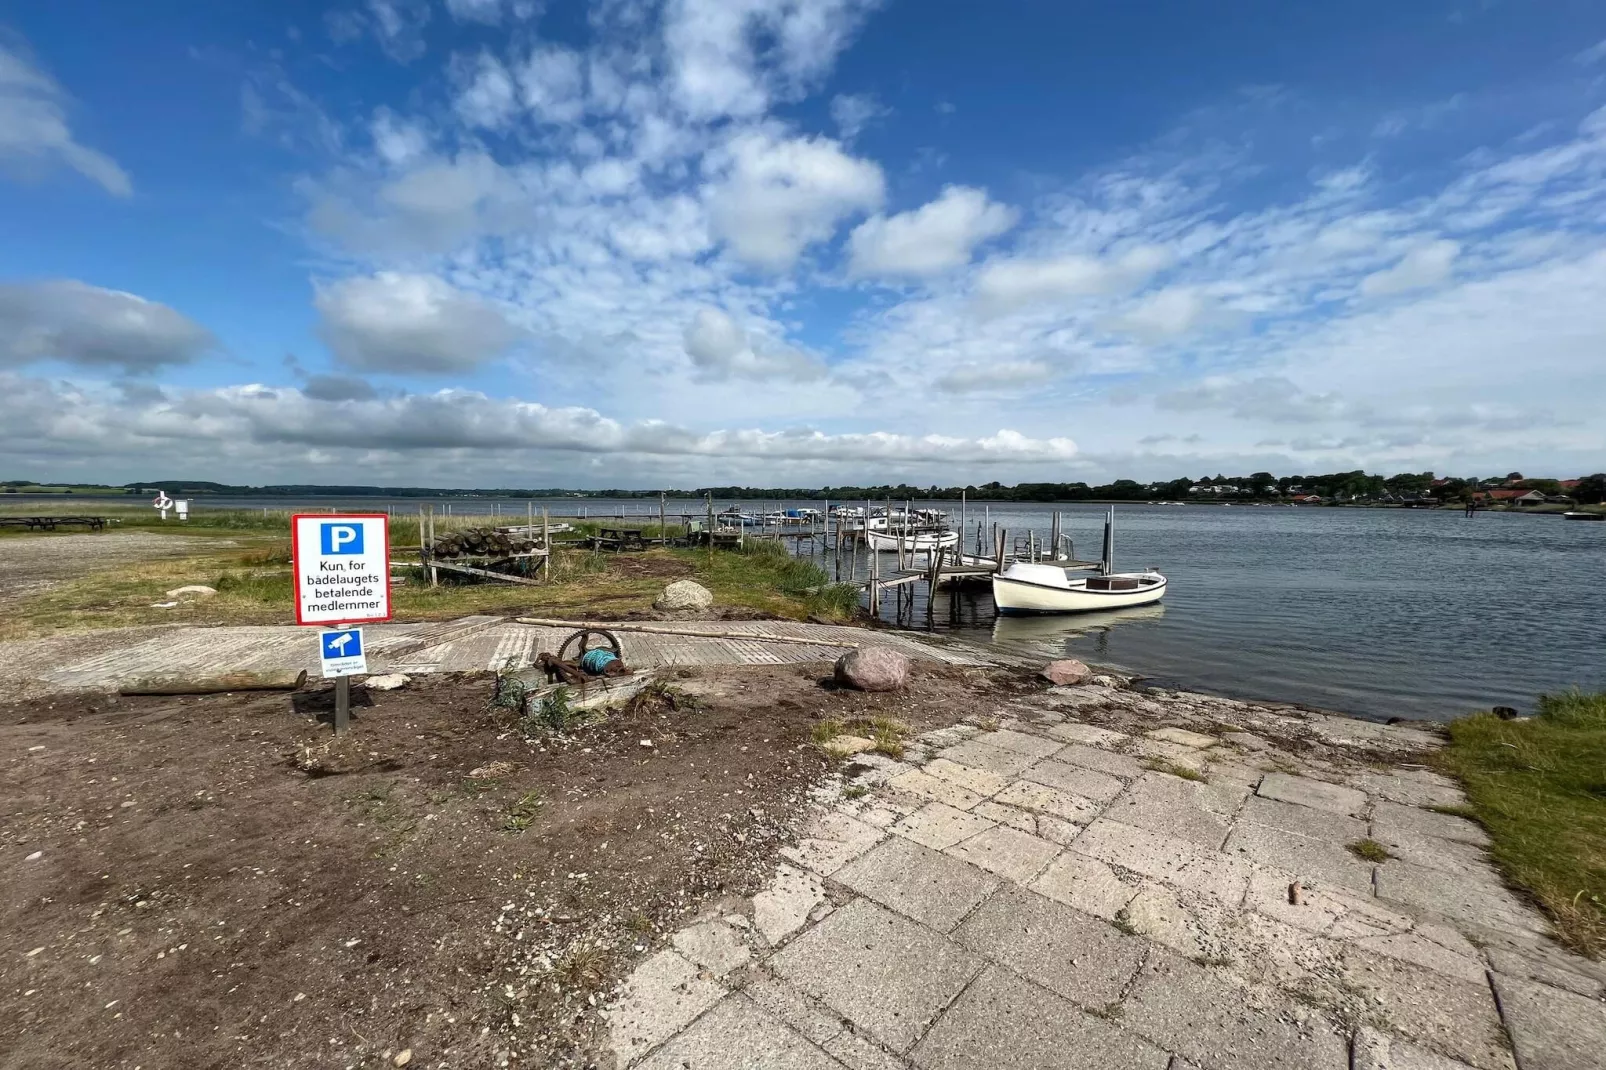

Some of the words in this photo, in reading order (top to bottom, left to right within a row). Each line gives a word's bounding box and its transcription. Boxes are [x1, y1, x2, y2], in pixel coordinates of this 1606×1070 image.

[331, 526, 357, 552] P
[349, 560, 366, 570] for
[307, 574, 379, 587] bådelaugets
[315, 587, 373, 599] betalende
[308, 601, 380, 612] medlemmer
